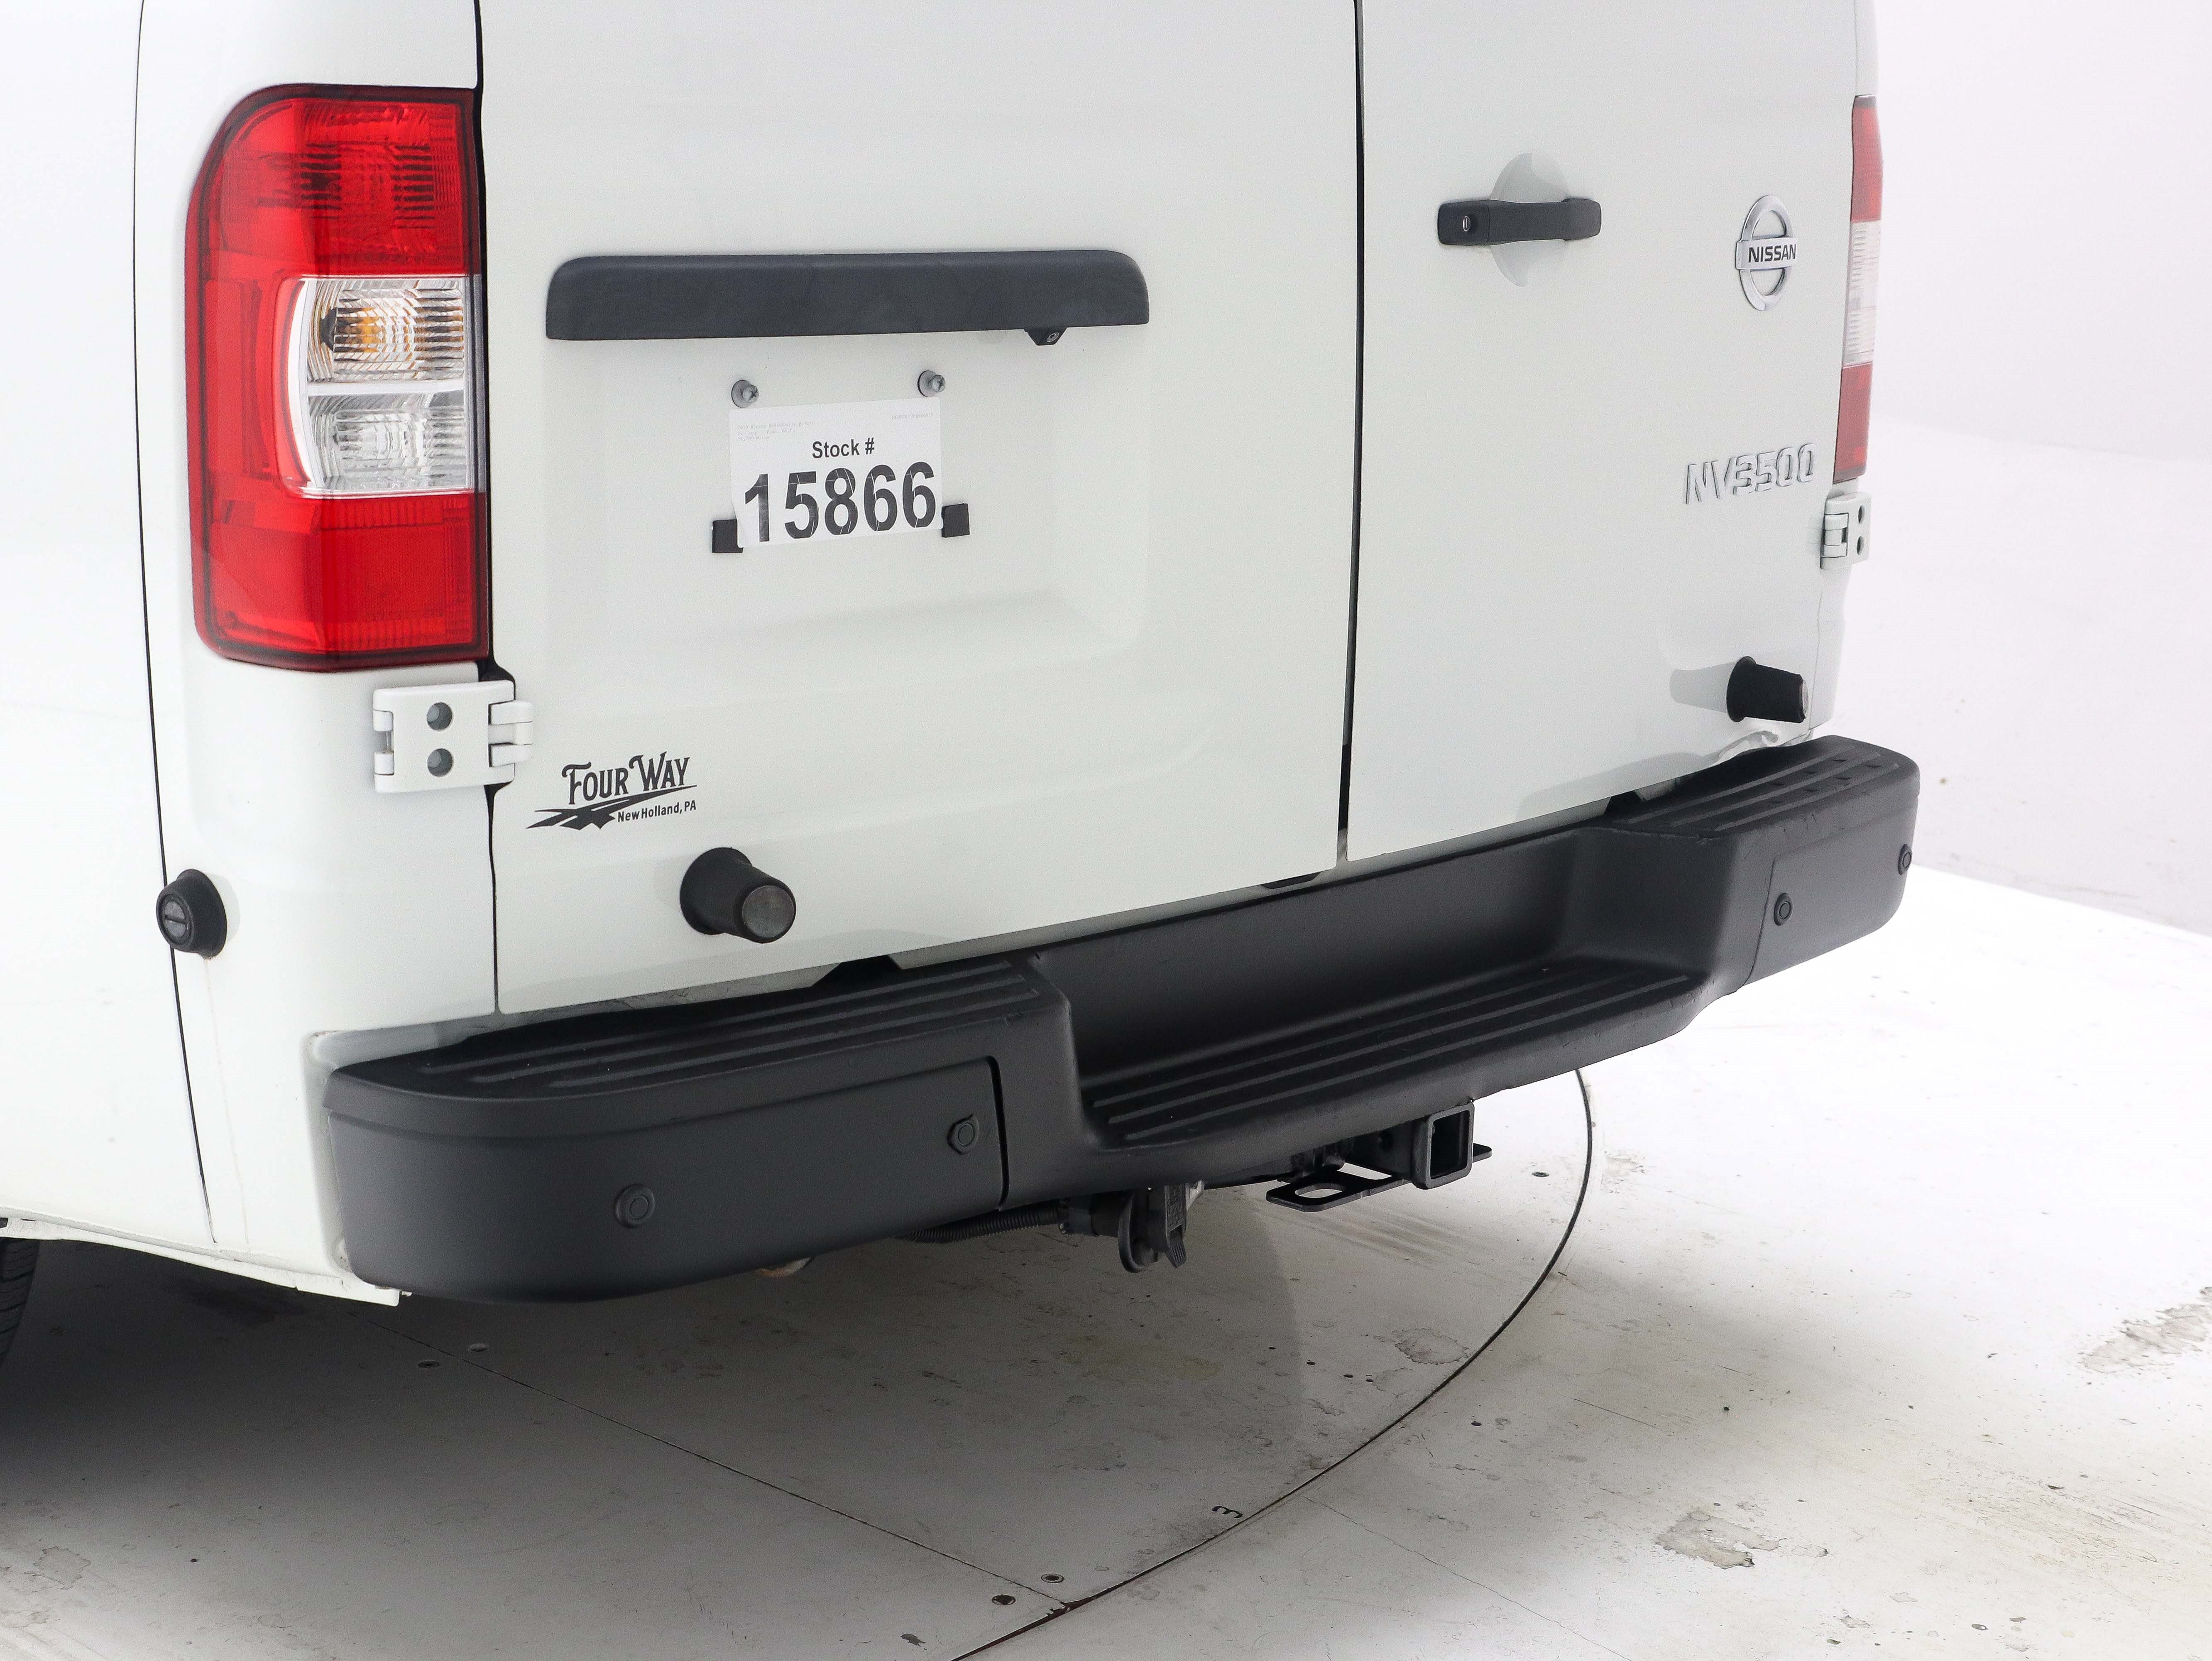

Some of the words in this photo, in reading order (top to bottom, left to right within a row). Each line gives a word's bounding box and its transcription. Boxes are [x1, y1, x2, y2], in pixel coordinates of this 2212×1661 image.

[1748, 243, 1796, 263] NISSAN
[812, 439, 860, 458] Stock
[865, 437, 875, 455] #
[1685, 443, 1814, 504] NV3500
[744, 461, 936, 542] 15866
[562, 762, 629, 805] FOUR
[629, 751, 690, 791] WAY
[618, 811, 640, 822] New
[641, 802, 682, 818] Holland,
[684, 800, 696, 811] PA
